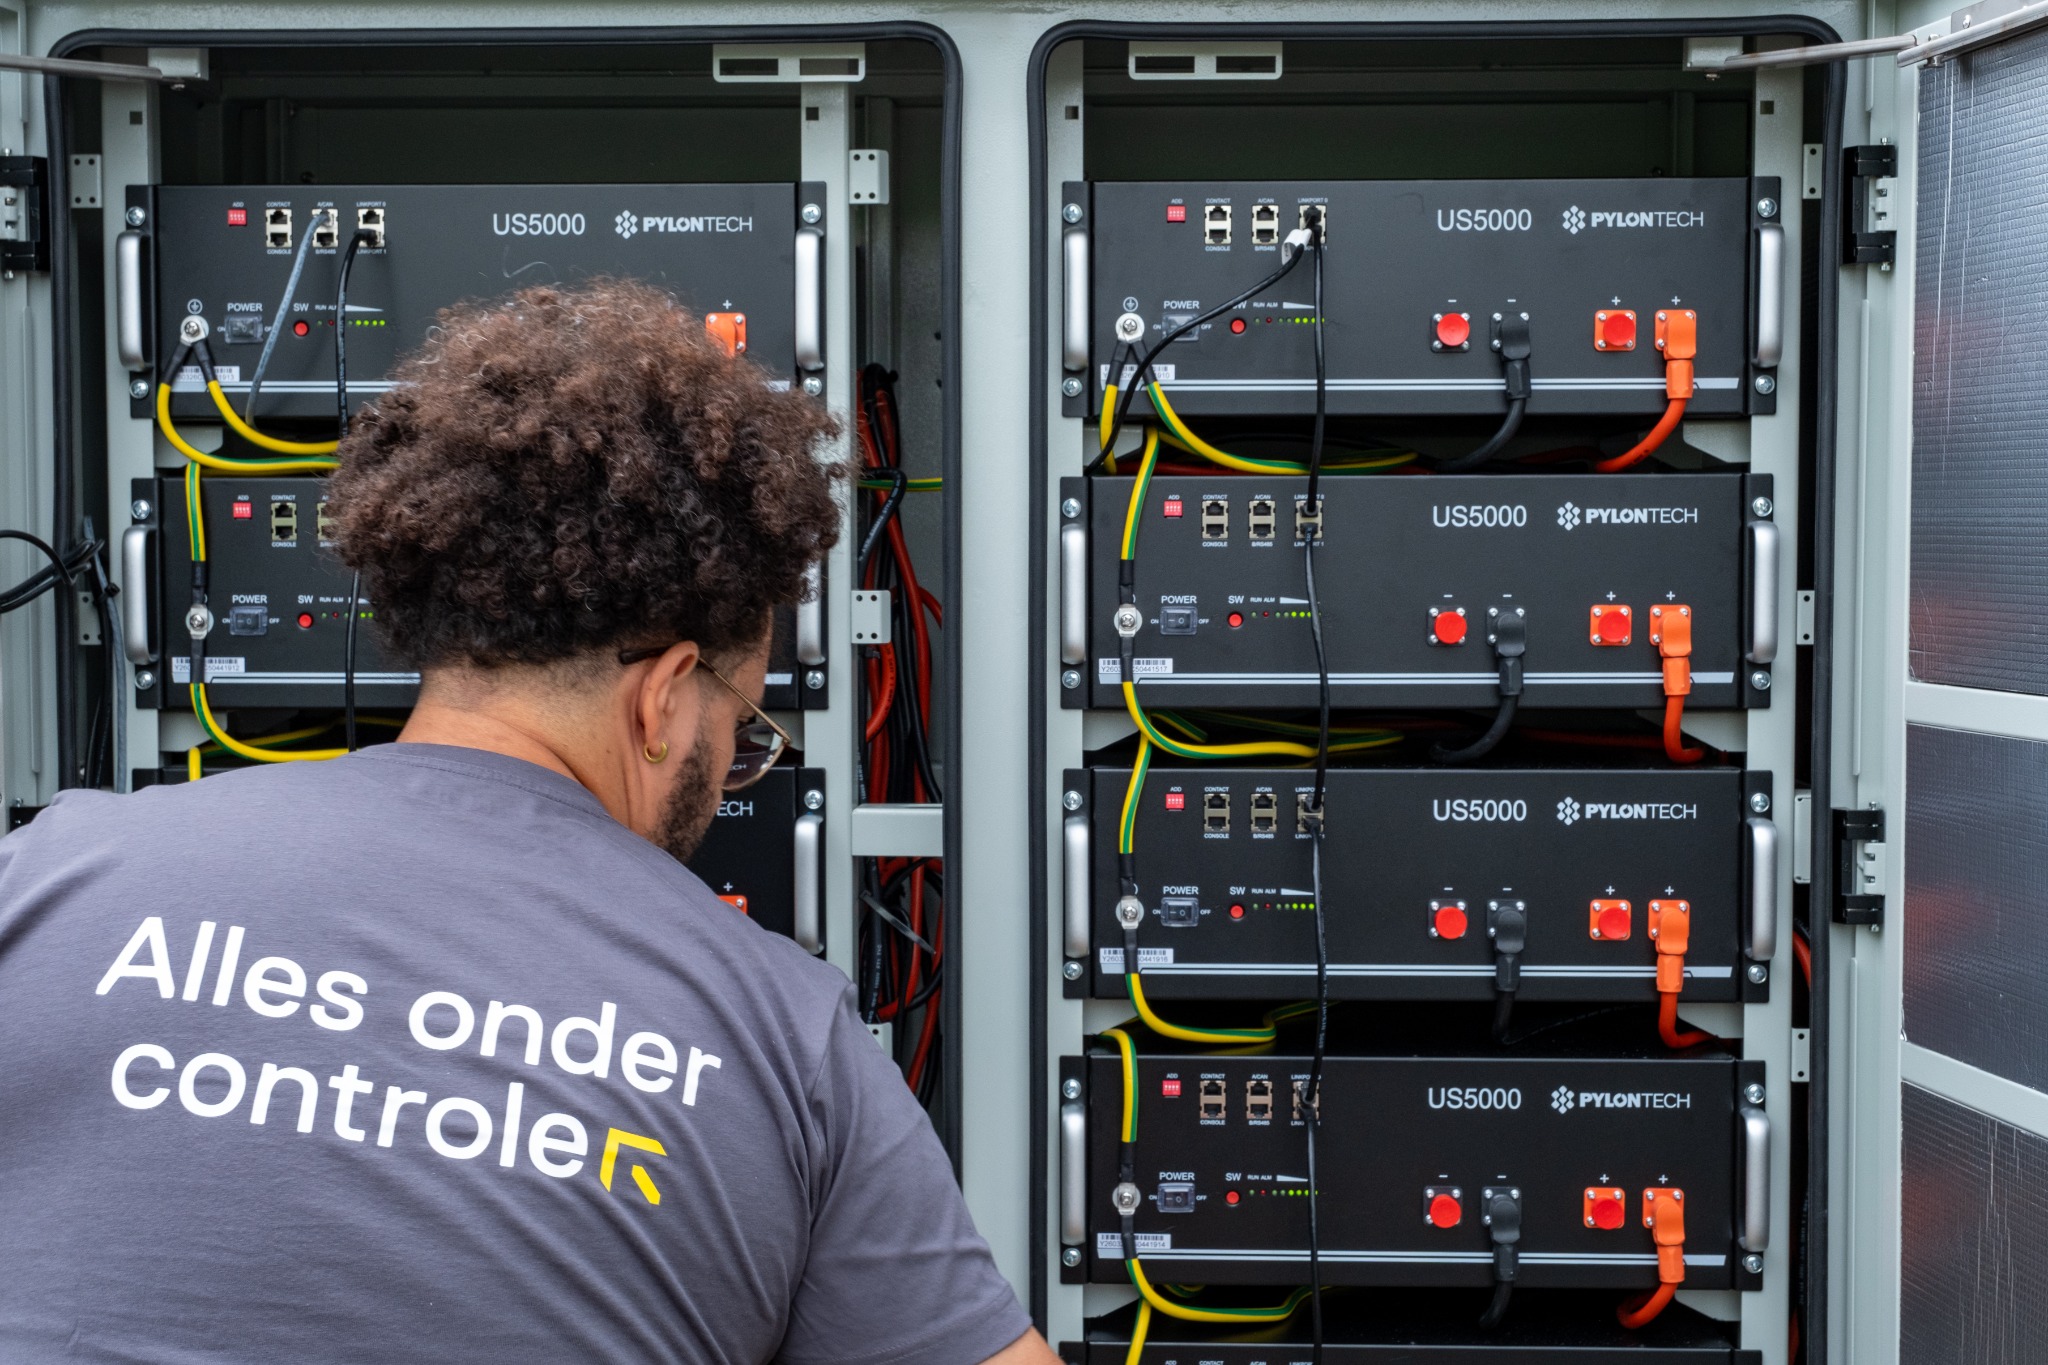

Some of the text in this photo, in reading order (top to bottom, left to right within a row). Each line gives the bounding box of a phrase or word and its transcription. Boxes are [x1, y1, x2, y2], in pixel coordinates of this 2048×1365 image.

[494, 212, 586, 236] US5000
[643, 216, 752, 232] PYLONTECH
[1437, 208, 1532, 232] US5000
[1591, 211, 1704, 228] PYLONTECH
[227, 302, 263, 312] POWER
[293, 302, 309, 312] SW
[1163, 300, 1200, 310] POWER
[1432, 504, 1528, 528] US5000
[1585, 507, 1698, 524] PYLONTECH
[232, 594, 268, 604] POWER
[297, 594, 314, 604] SW
[1161, 595, 1197, 605] POWER
[1228, 595, 1244, 604] SW
[1433, 798, 1527, 822] US5000
[1585, 803, 1697, 819] PYLONTECH
[1162, 885, 1199, 895] POWER
[1229, 885, 1246, 895] SW
[95, 916, 722, 1107] Alles onder
[1428, 1087, 1522, 1110] US5000
[1579, 1093, 1690, 1109] PYLONTECH
[110, 1042, 589, 1179] controle
[1159, 1171, 1195, 1182] POWER
[1225, 1172, 1242, 1182] SW
